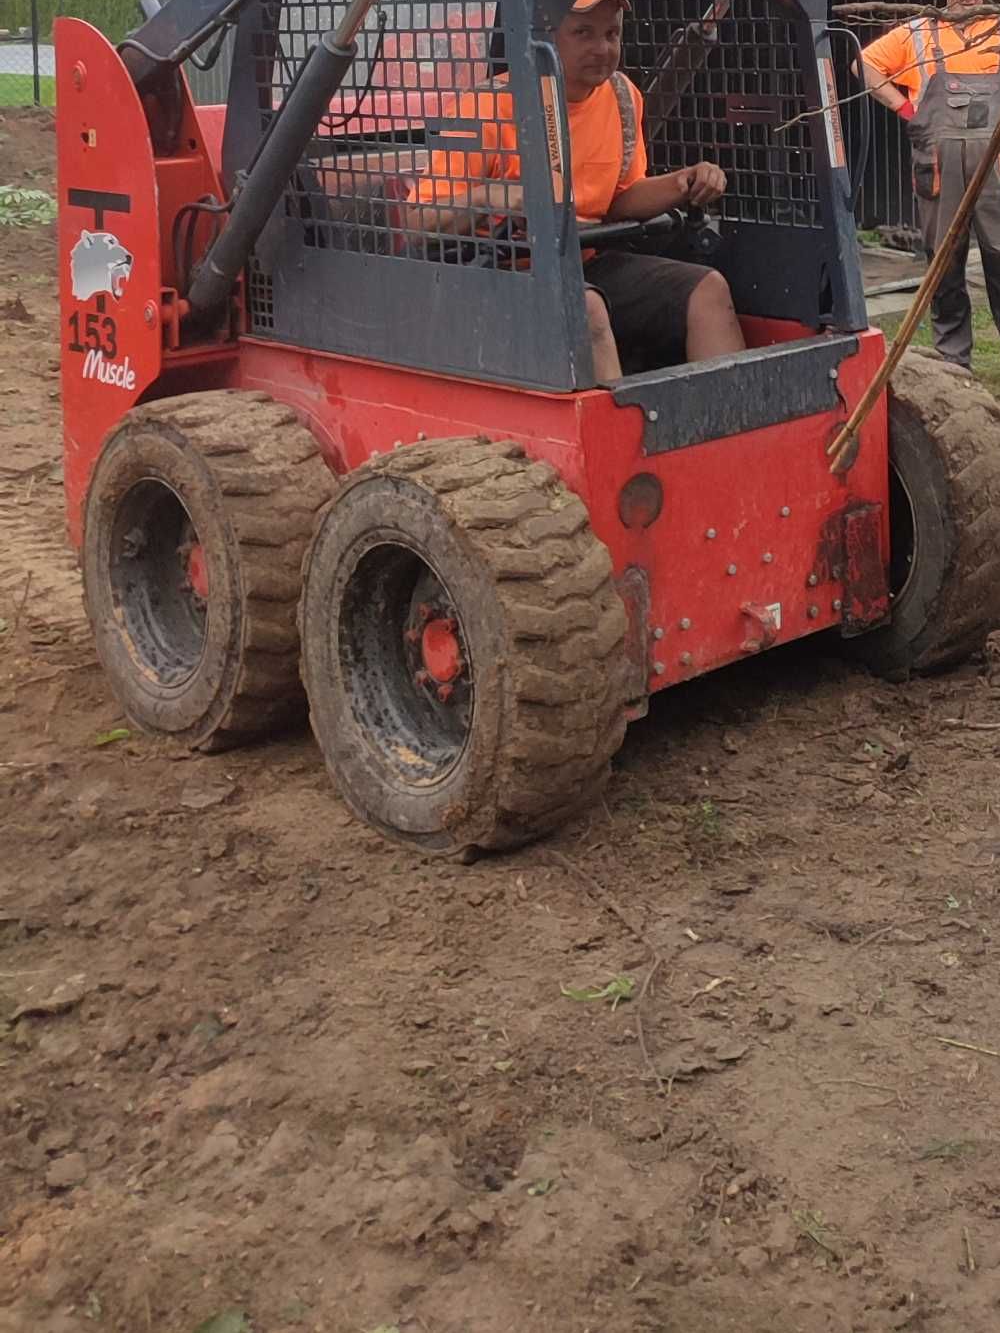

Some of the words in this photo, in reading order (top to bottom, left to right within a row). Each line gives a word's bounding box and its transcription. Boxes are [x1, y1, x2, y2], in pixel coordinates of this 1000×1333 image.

[545, 104, 558, 161] WARNING
[68, 310, 117, 359] 153
[83, 348, 136, 390] Muscle
